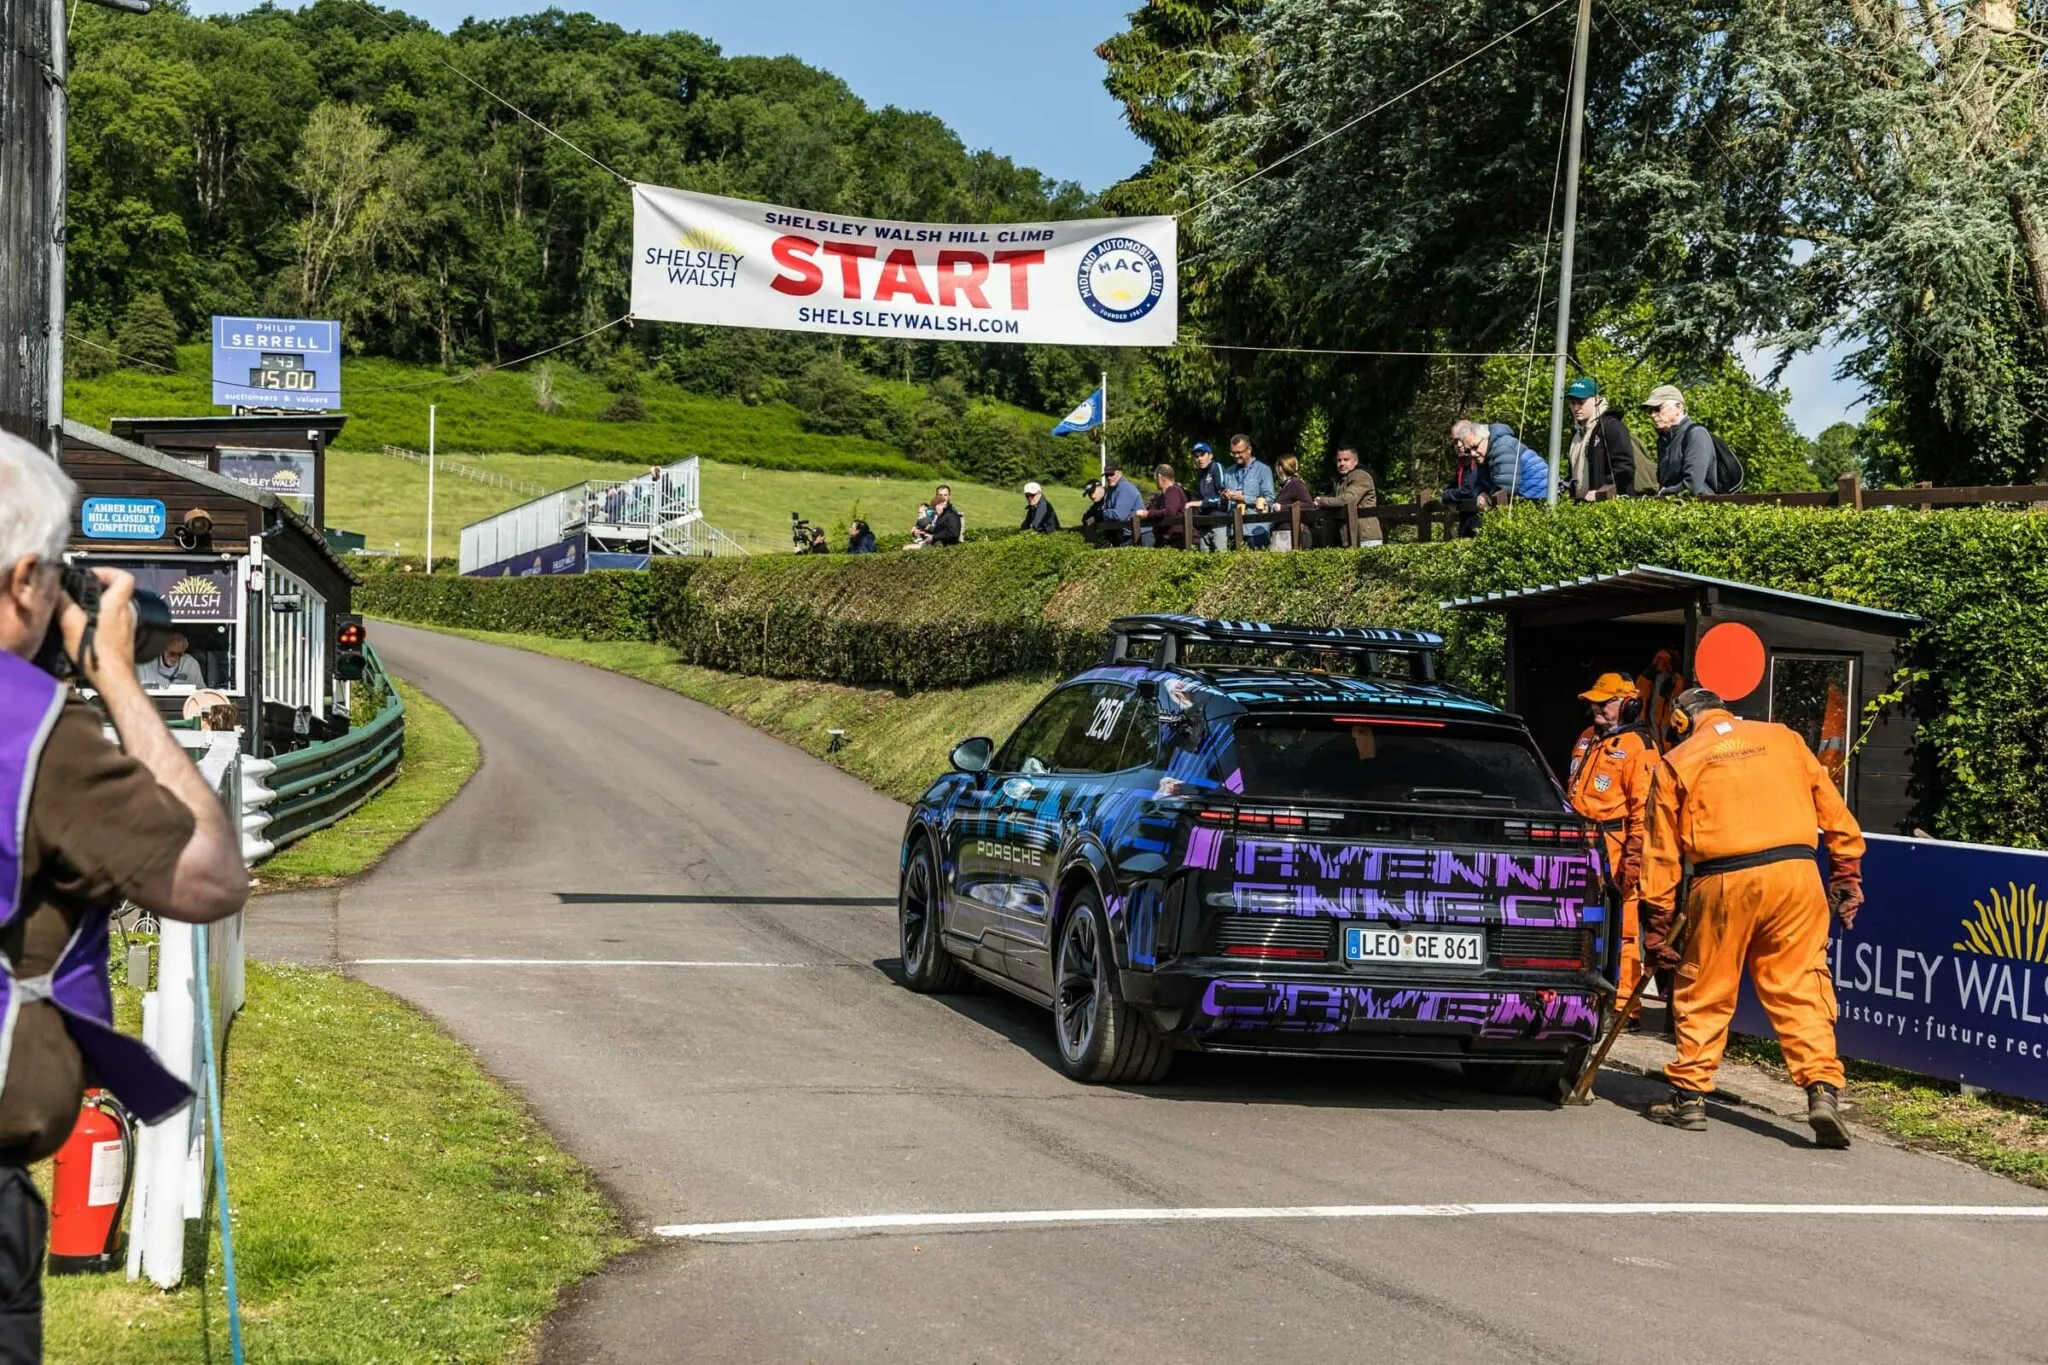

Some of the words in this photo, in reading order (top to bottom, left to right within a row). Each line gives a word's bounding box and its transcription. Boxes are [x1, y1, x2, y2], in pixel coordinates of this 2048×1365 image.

[765, 212, 867, 236] SHELSLEY
[875, 227, 948, 243] WALSH
[949, 231, 990, 243] HILL
[997, 229, 1055, 243] CLIMB
[645, 247, 745, 271] SHELSLEY
[1079, 251, 1097, 299] MIDLAND
[1097, 239, 1158, 268] AUTOMOBILE
[1150, 269, 1163, 297] CLUB
[1098, 258, 1144, 273] MAC
[667, 267, 737, 288] WALSH
[769, 234, 1045, 311] START
[256, 323, 296, 333] PHILIP
[798, 307, 1019, 334] SHELSLEYWALSH.COM
[231, 334, 318, 349] SERRELL
[224, 393, 277, 402] auctioneers
[88, 513, 109, 522] HILL
[111, 513, 146, 523] CLOSED
[148, 515, 160, 524] TO
[94, 503, 125, 513] AMBER
[128, 504, 156, 514] LIGHT
[93, 522, 156, 533] COMPETITORS
[169, 594, 221, 608] WALSH
[977, 840, 1041, 867] PORSCHE
[1362, 933, 1400, 956] LEO
[1415, 936, 1439, 958] GE
[1444, 937, 1478, 960] 861
[1826, 937, 1944, 1004] LSLEY
[1953, 956, 2048, 1025] WAL
[2006, 1037, 2048, 1059] rec
